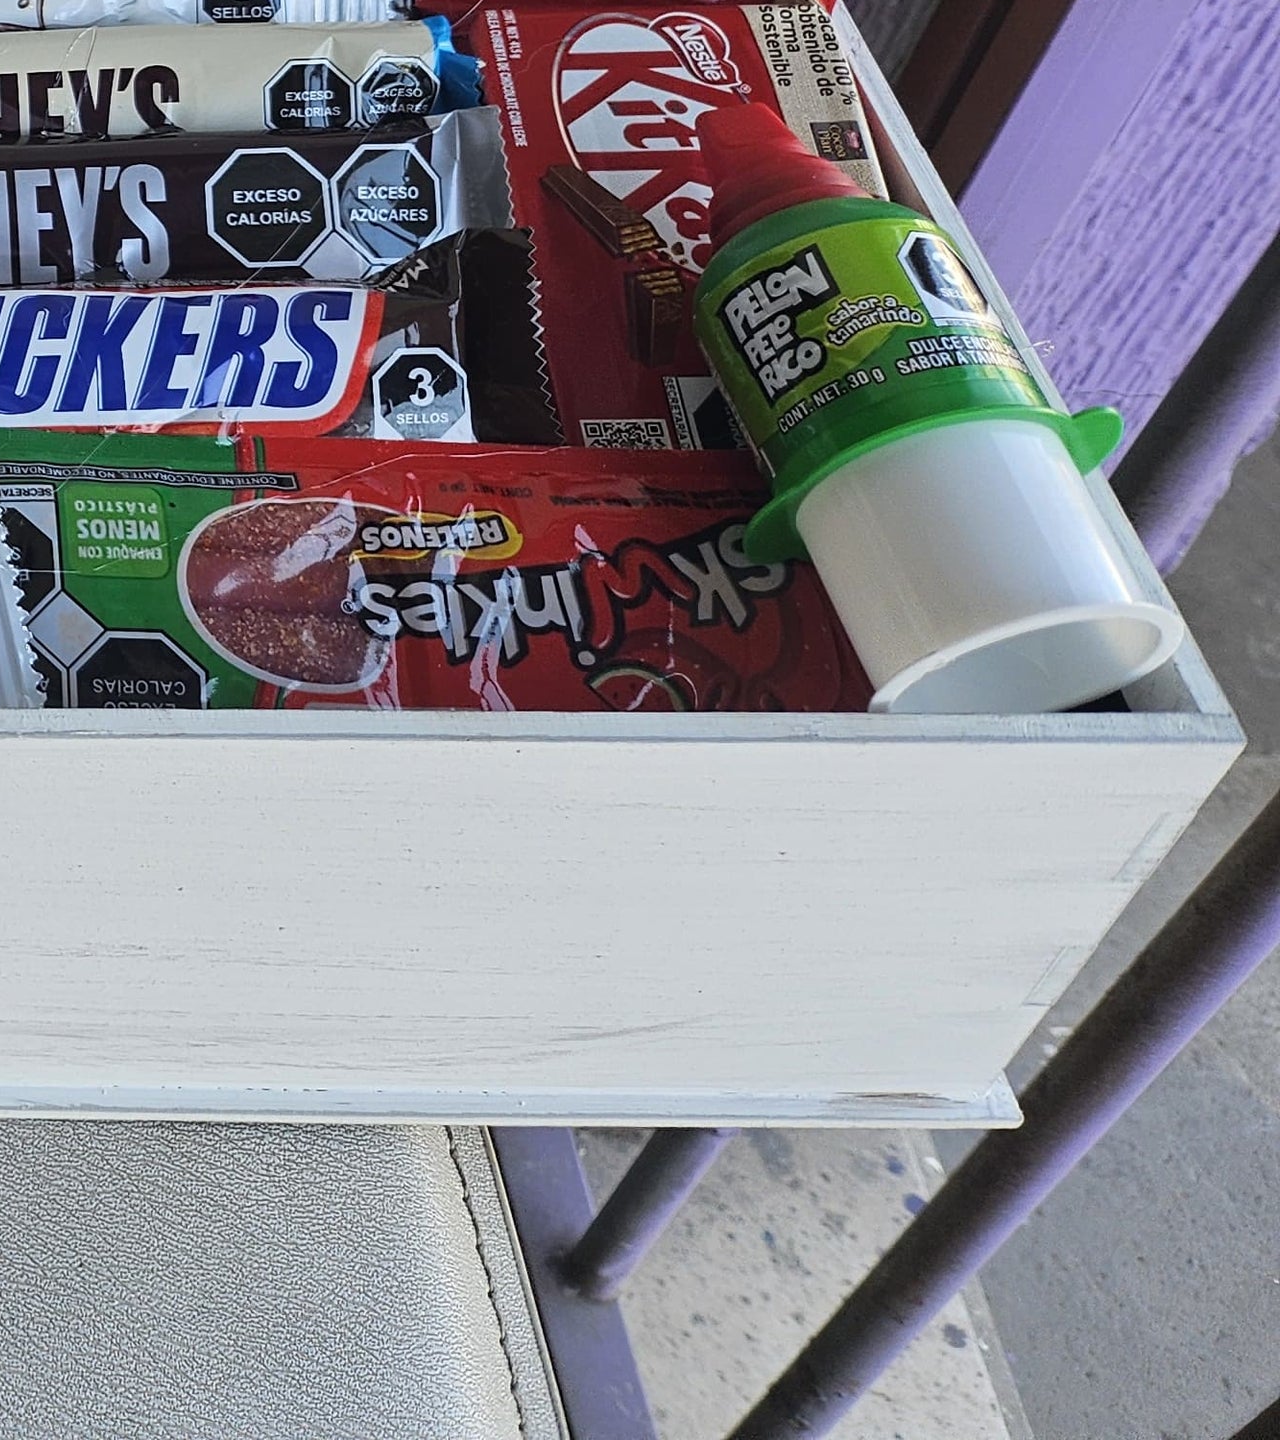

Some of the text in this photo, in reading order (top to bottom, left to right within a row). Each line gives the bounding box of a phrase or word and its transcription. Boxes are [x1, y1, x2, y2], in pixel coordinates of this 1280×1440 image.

[212, 4, 273, 20] SELLOS
[759, 6, 793, 87] sostenible
[798, 5, 836, 97] obtenido de
[830, 57, 852, 86] 100
[841, 90, 857, 106] %
[285, 90, 334, 102] EXCESO
[374, 87, 423, 98] EXCESO
[512, 126, 528, 147] LECHE
[232, 188, 302, 204] EXCESO
[357, 185, 420, 200] EXCESO
[226, 207, 313, 227] CALORÍAS
[350, 205, 430, 223] AZÚCARES
[725, 252, 830, 344] PELON
[828, 297, 897, 327] sabor a
[828, 307, 922, 345] tamarindo
[743, 314, 794, 369] PELO
[908, 335, 963, 355] DULCE
[758, 341, 822, 399] RICO
[896, 351, 945, 374] SABOR
[955, 351, 969, 365] A
[408, 366, 434, 407] 3
[779, 368, 886, 434] CONT. NET. 30 g
[396, 412, 449, 426] SELLOS
[0, 465, 97, 479] RECOMENDABLE
[98, 470, 116, 479] NO
[218, 475, 278, 486] CONTIENE
[74, 499, 158, 517] PLÁSTICO
[76, 518, 160, 541] MENOS
[361, 518, 505, 552] RELLENOS
[78, 543, 163, 560] EMPAQUE CON
[92, 678, 186, 697] CALORÍAS
